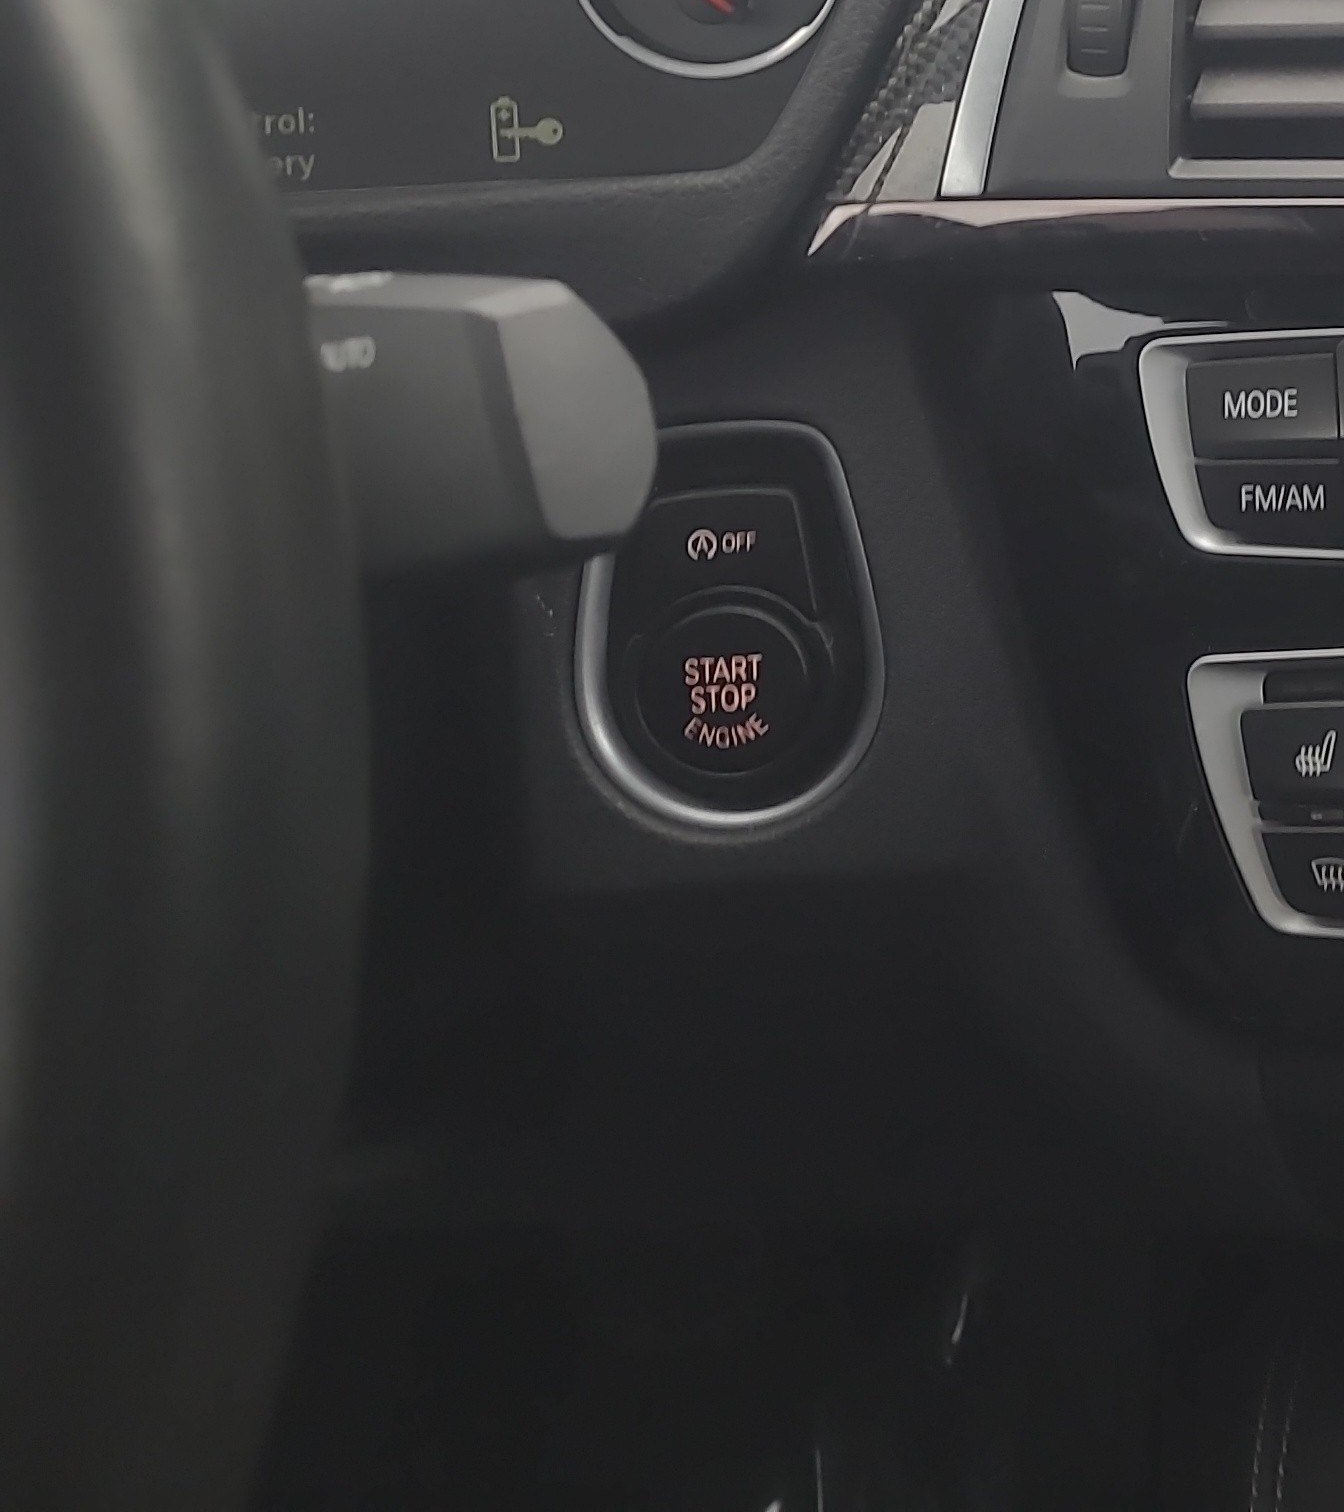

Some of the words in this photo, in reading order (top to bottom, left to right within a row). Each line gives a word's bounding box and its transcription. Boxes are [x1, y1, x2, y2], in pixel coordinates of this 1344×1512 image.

[1224, 388, 1299, 420] MODE
[1240, 483, 1326, 513] FM/AM
[721, 530, 758, 555] OFF
[684, 652, 763, 687] START
[691, 682, 757, 715] STOP
[683, 712, 770, 750] ENGINE
